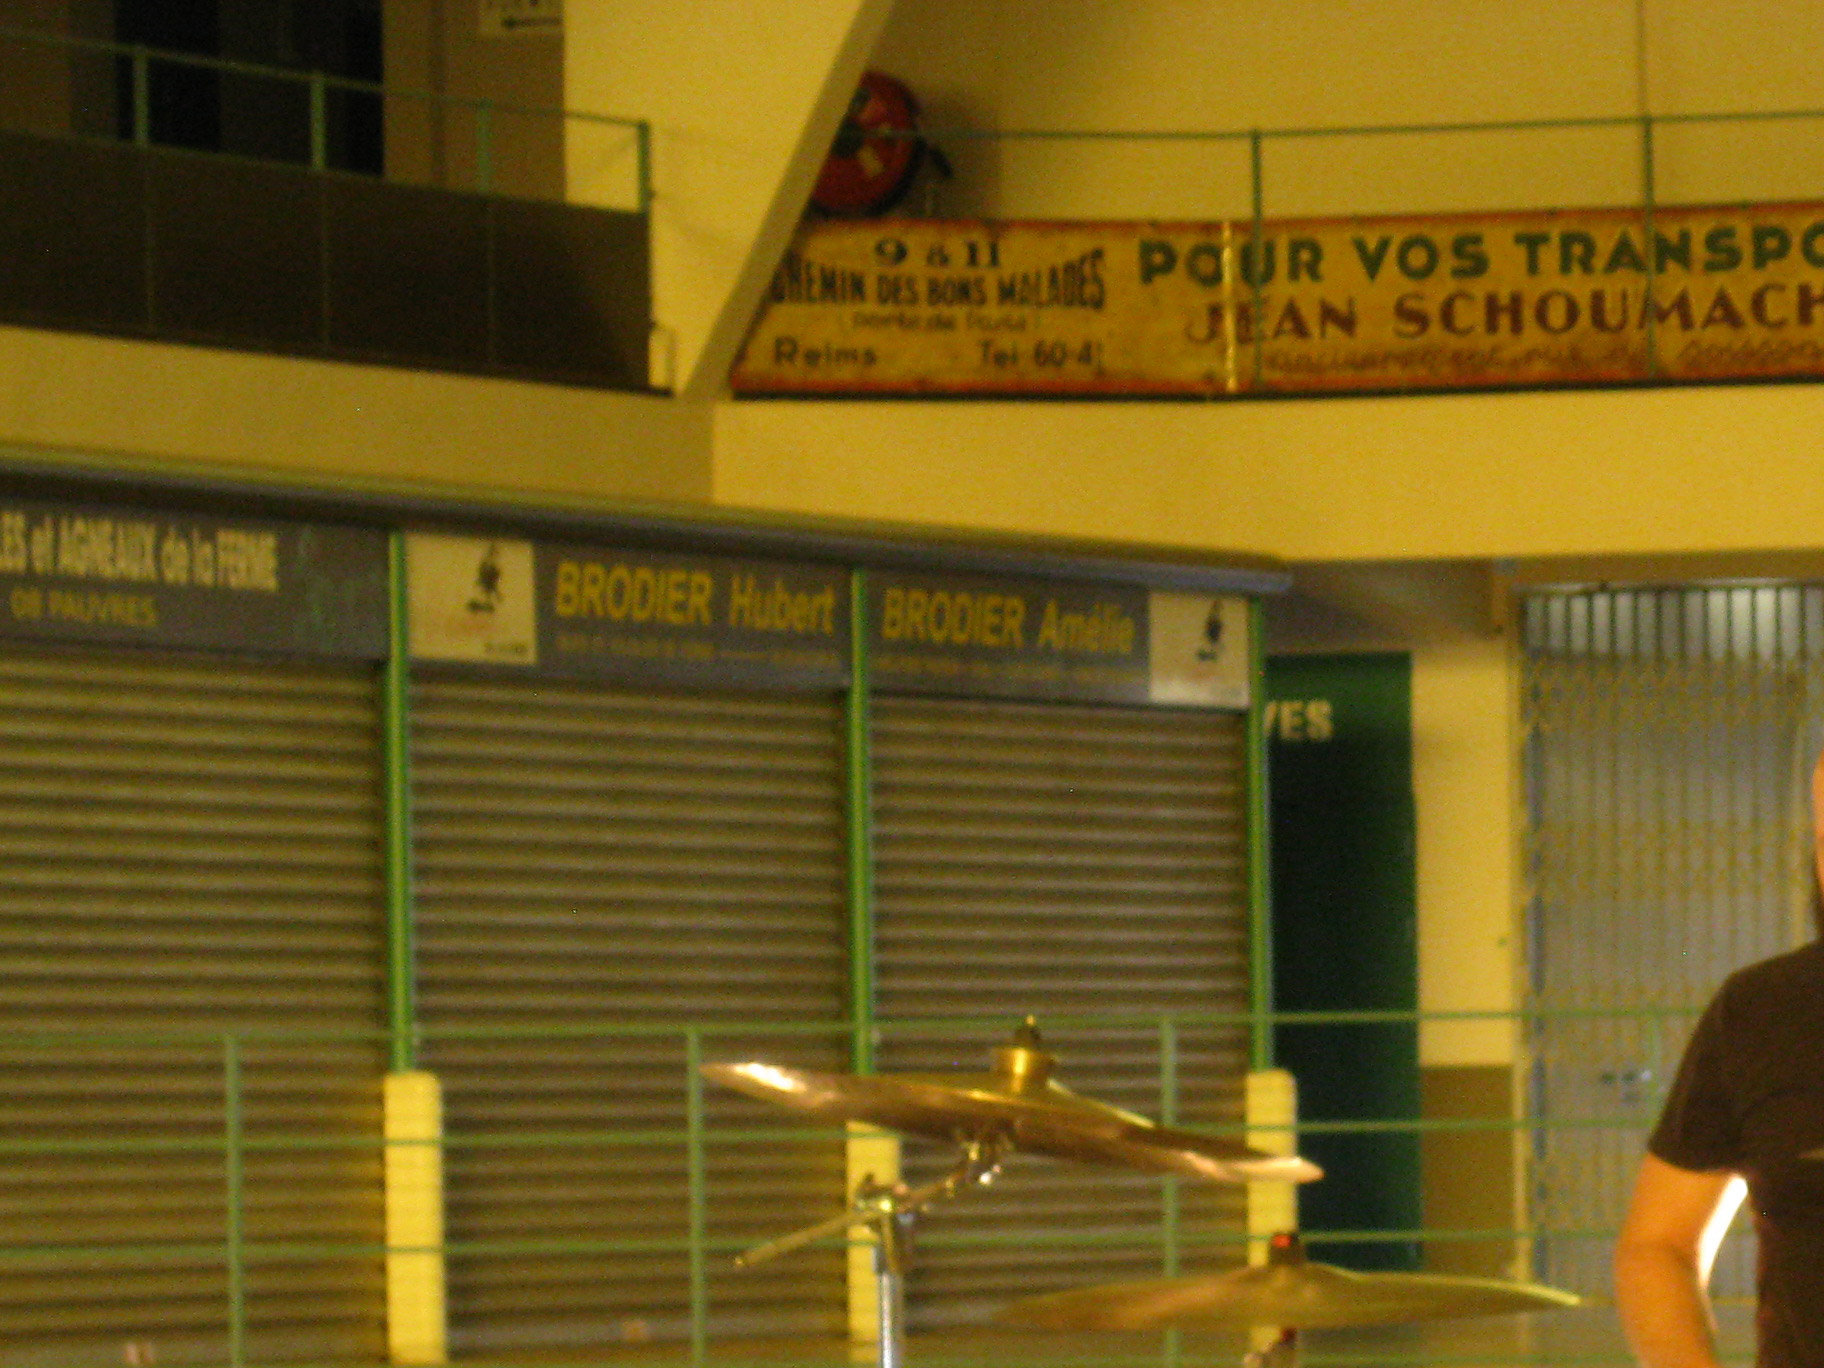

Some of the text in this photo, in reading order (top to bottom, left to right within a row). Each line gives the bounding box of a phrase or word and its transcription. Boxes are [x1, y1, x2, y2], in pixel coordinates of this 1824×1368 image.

[873, 238, 908, 269] 9
[876, 274, 920, 305] DES
[926, 275, 988, 306] BONS
[996, 246, 1105, 311] MALADES
[1138, 236, 1325, 288] POUR
[1353, 231, 1490, 282] VOS
[1186, 295, 1358, 345] JEAN
[773, 335, 877, 367] Reims
[554, 561, 837, 637] BRODIER Hubert
[881, 587, 1027, 650] BRODIER
